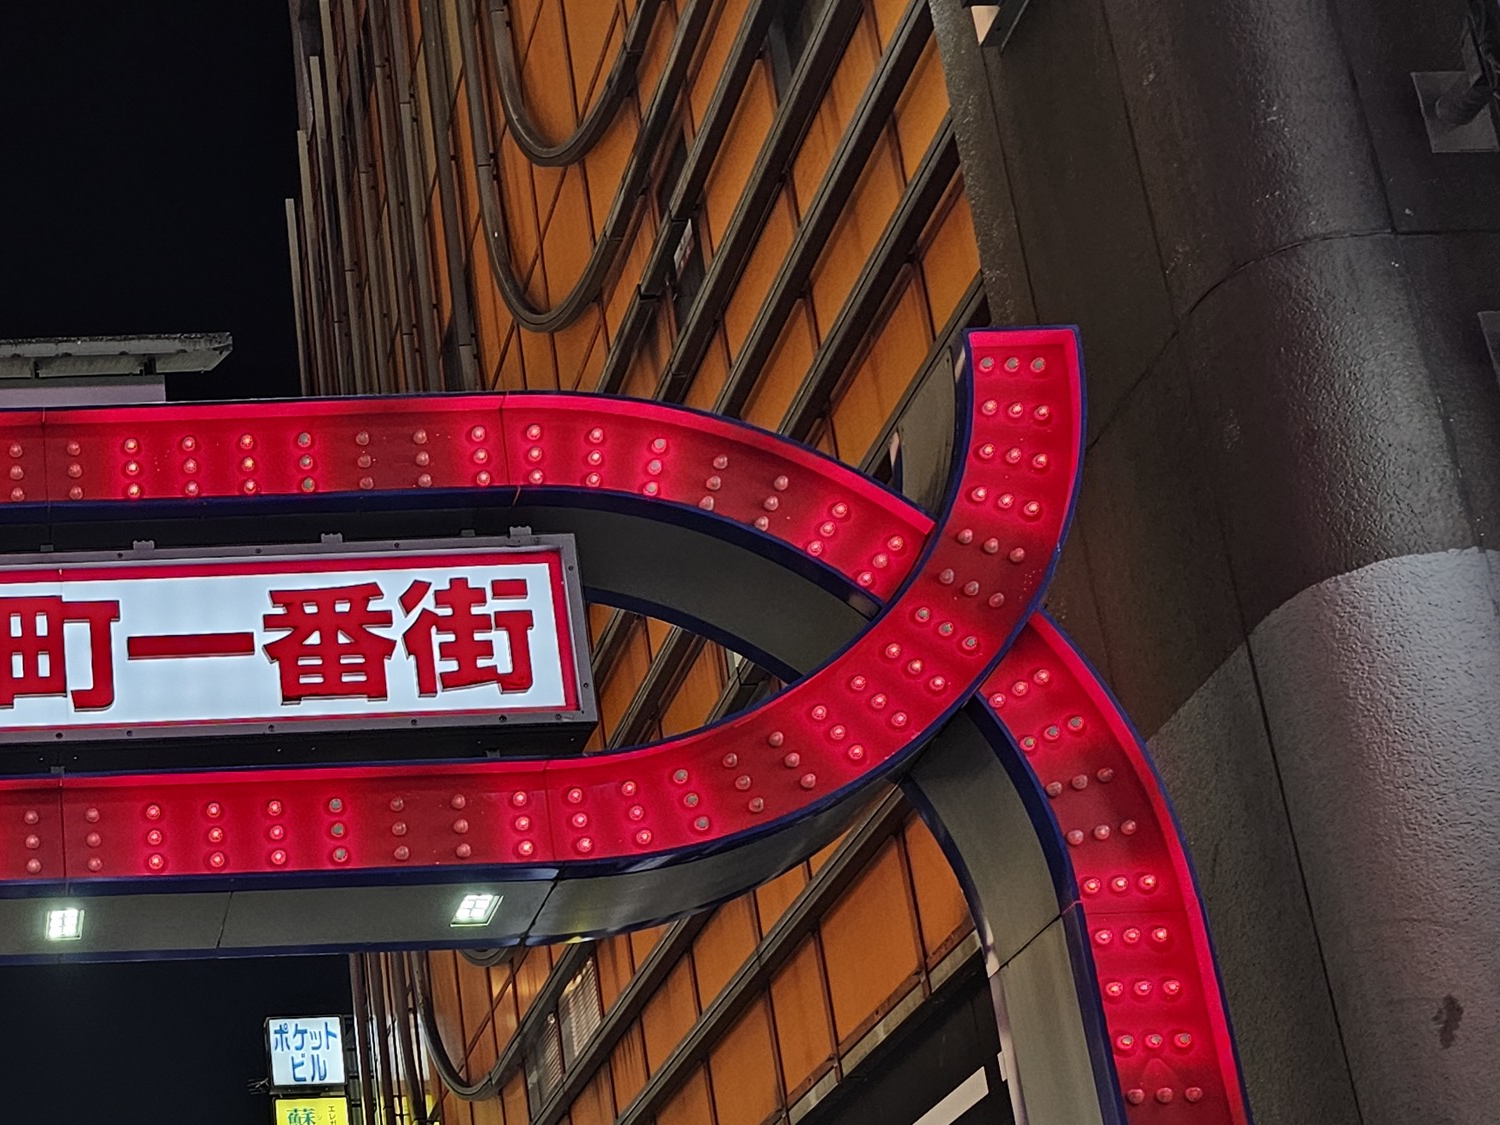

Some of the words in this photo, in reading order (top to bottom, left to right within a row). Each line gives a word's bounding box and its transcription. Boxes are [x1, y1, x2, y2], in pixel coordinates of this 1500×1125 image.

[273, 1022, 338, 1052] ポケット
[292, 1054, 327, 1082] ビル
